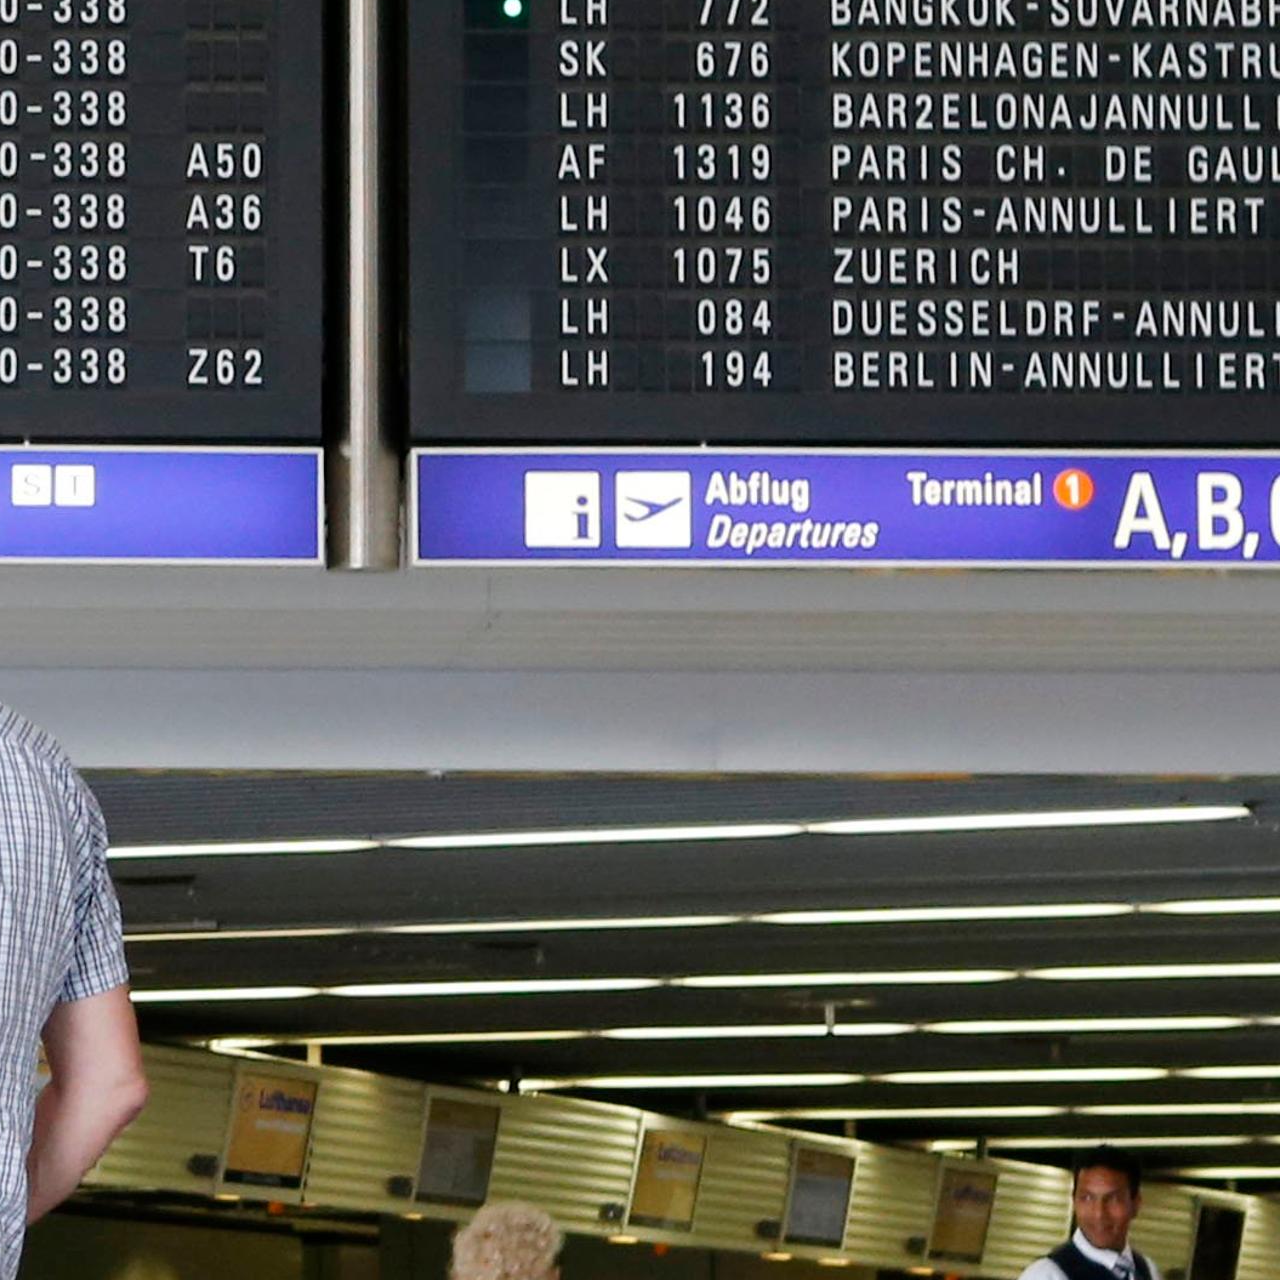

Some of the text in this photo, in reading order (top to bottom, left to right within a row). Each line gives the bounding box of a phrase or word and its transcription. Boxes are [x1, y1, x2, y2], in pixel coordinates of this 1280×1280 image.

[187, 143, 260, 178] A50
[833, 145, 1151, 181] PARIS CH. DE
[834, 197, 1264, 233] PARIS-ANNULLIERT
[834, 248, 1017, 284] ZUERICH
[189, 349, 262, 384] Z62
[705, 470, 811, 513] Abflug
[906, 471, 1080, 506] Terminal 1
[706, 514, 879, 555] Departures
